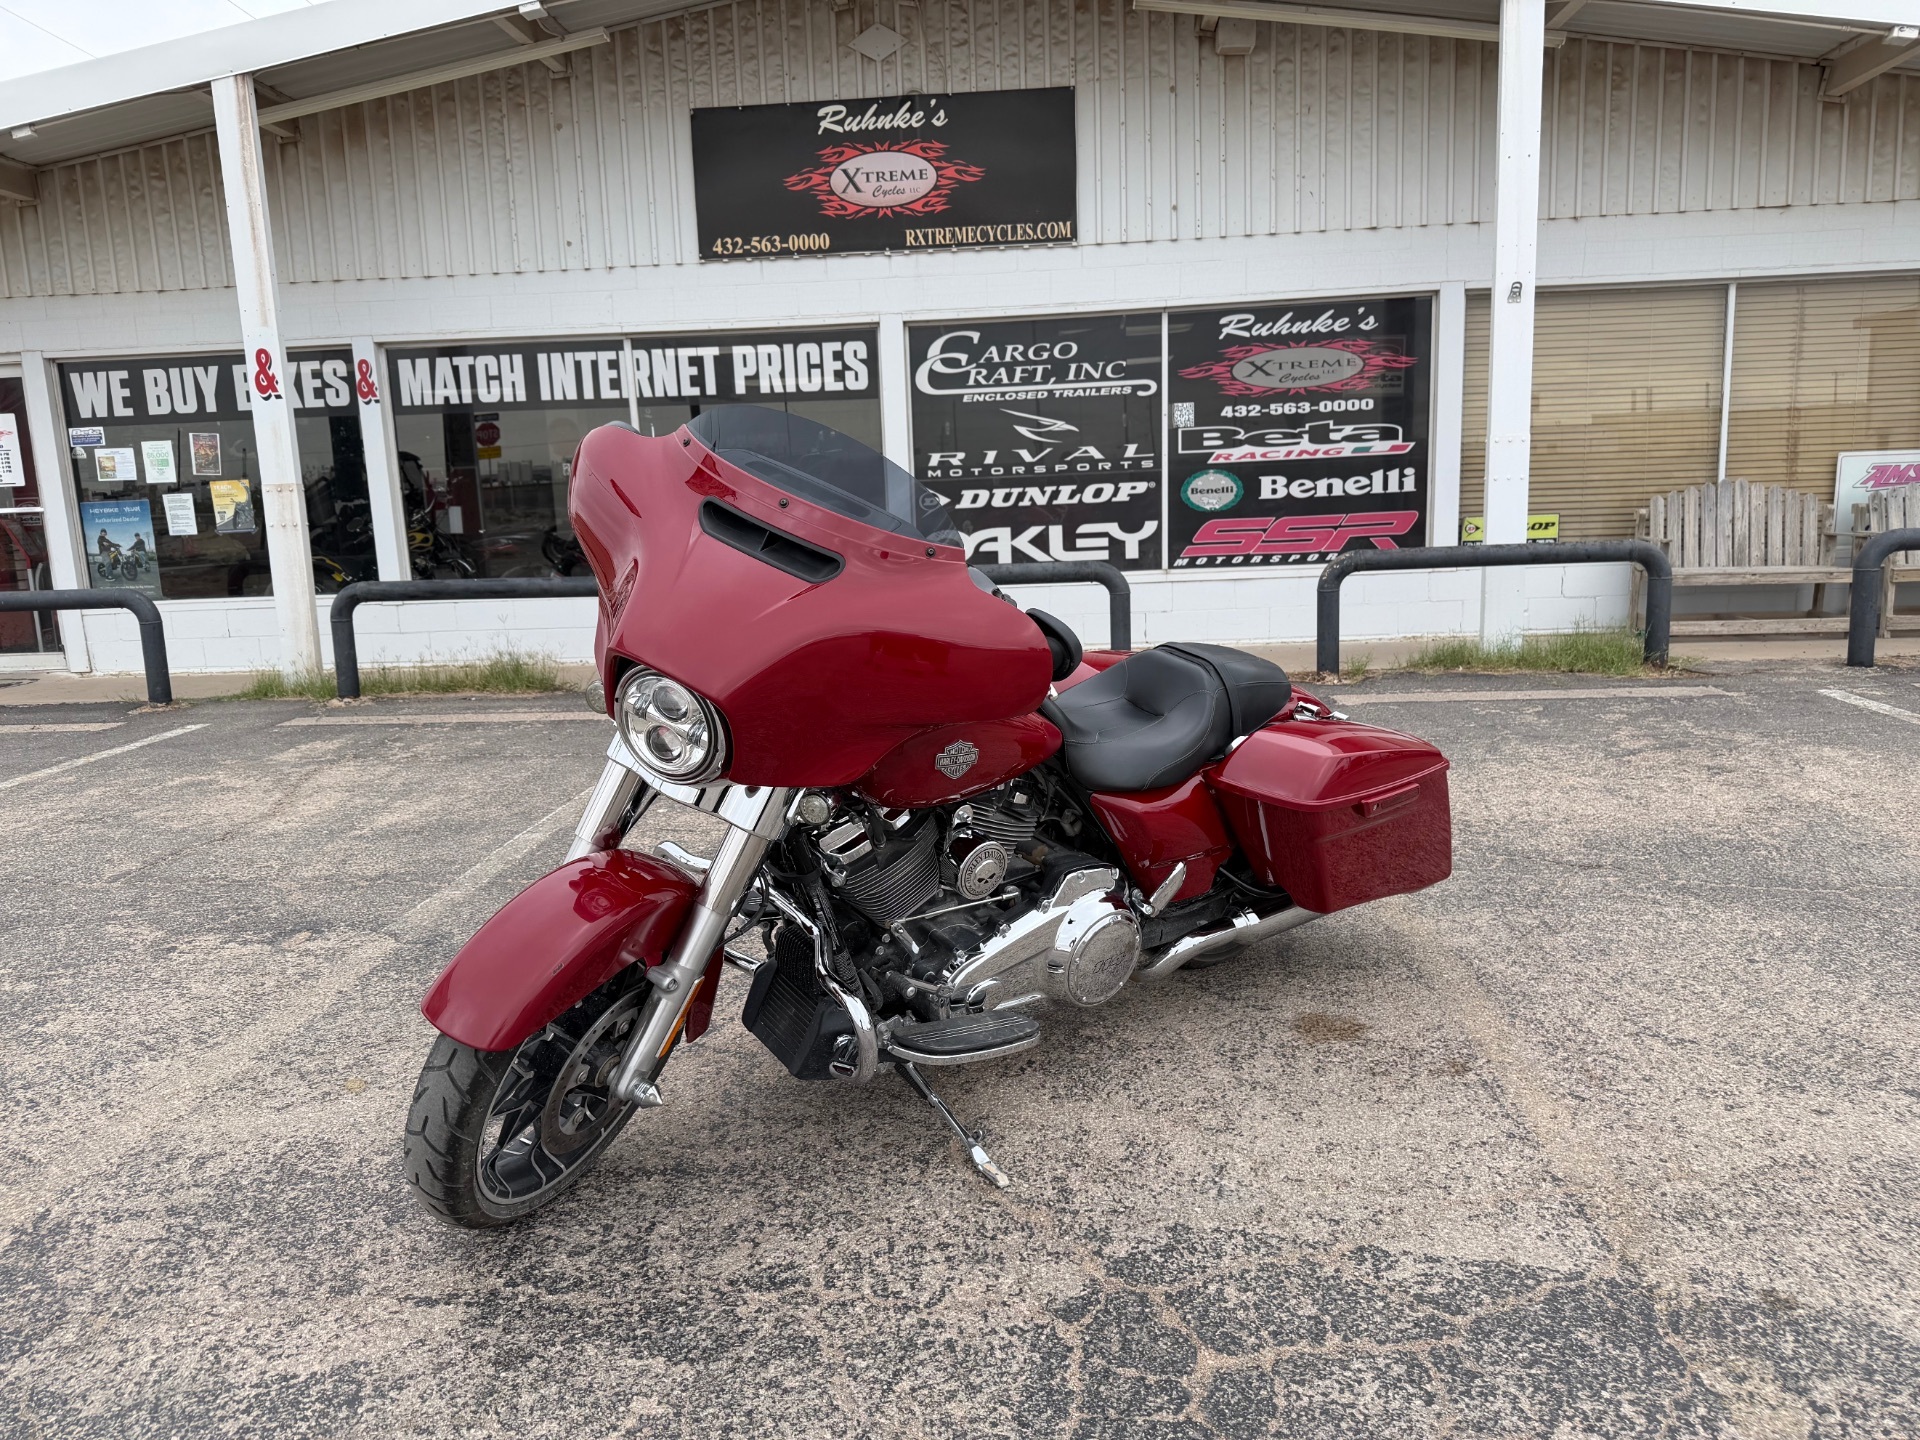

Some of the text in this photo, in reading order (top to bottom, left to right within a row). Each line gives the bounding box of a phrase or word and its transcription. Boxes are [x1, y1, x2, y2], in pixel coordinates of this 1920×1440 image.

[817, 99, 948, 135] Ruhnke's
[839, 167, 929, 195] XTREME
[872, 184, 906, 198] Cycles
[712, 232, 830, 255] 432-563-0000
[906, 221, 1072, 246] RXTREMECYCLES.COM
[1218, 307, 1379, 340] Ruhnke's
[927, 331, 1078, 374] CARGO
[255, 348, 283, 401] &
[397, 340, 869, 407] MATCH INTERNET PRICES
[1065, 361, 1126, 381] INC
[1242, 356, 1357, 379] XTREME
[1278, 373, 1320, 384] Cycles
[70, 359, 350, 419] WE BUY BKES
[357, 359, 380, 405] &
[962, 386, 1132, 403] ENCLOSED TRAILERS
[1220, 398, 1375, 418] 432-563-0000
[1178, 420, 1403, 454] Beta
[927, 443, 1155, 467] RIVAL
[1210, 447, 1345, 462] RACING
[927, 460, 1154, 478] MOTORSPORTS
[954, 481, 1149, 509] DUNLOP
[1190, 485, 1234, 496] Benelli
[1258, 467, 1417, 500] Benelli
[1180, 511, 1419, 557] SSR
[1173, 552, 1339, 567] MOTORSPOR
